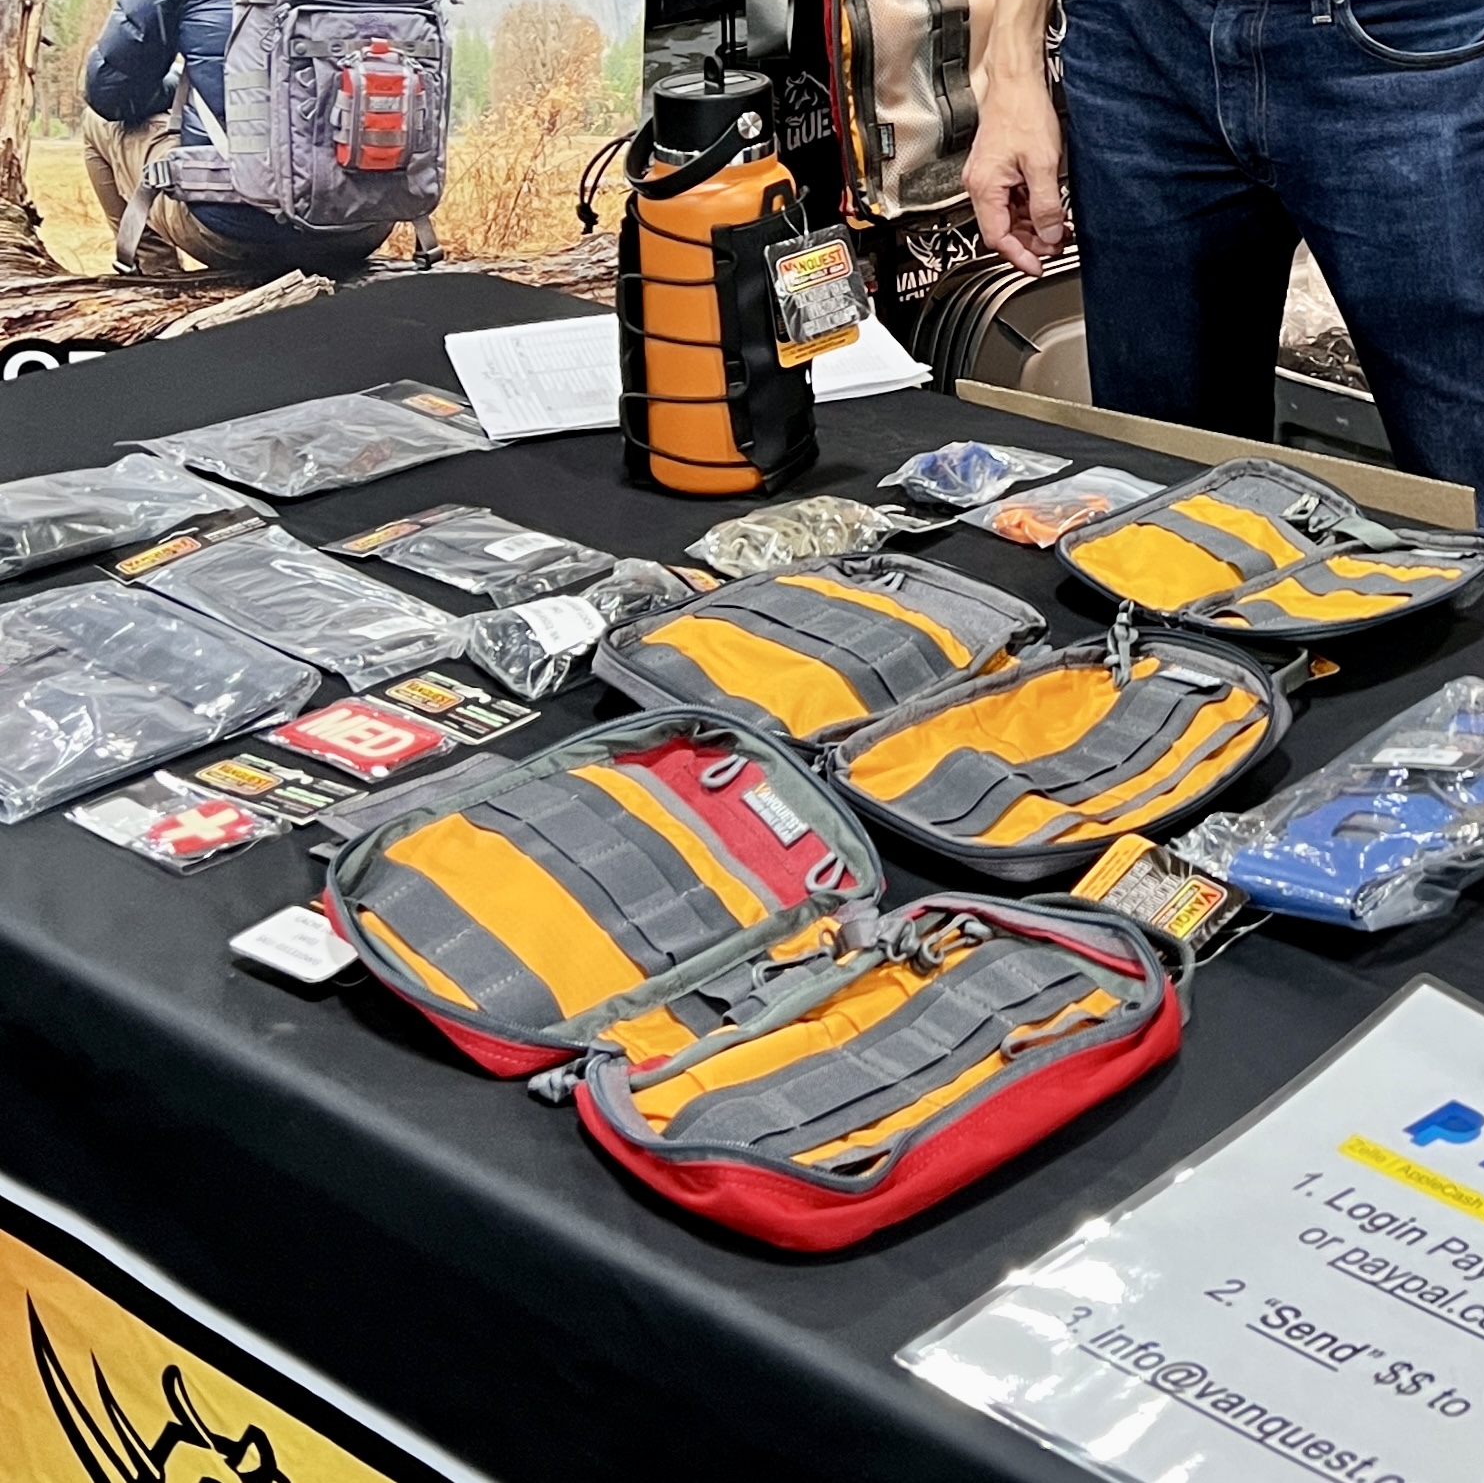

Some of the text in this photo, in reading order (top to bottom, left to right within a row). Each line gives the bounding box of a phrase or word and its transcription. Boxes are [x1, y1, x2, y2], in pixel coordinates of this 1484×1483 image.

[295, 706, 416, 757] MED
[1167, 890, 1218, 934] VANQU
[1291, 1171, 1324, 1198] 1.
[1323, 1186, 1429, 1248] Login
[1400, 1163, 1484, 1213] AppleCash
[1298, 1224, 1345, 1251] or
[1203, 1278, 1247, 1307] 2.
[1374, 1359, 1436, 1398] $$
[1427, 1386, 1472, 1419] to
